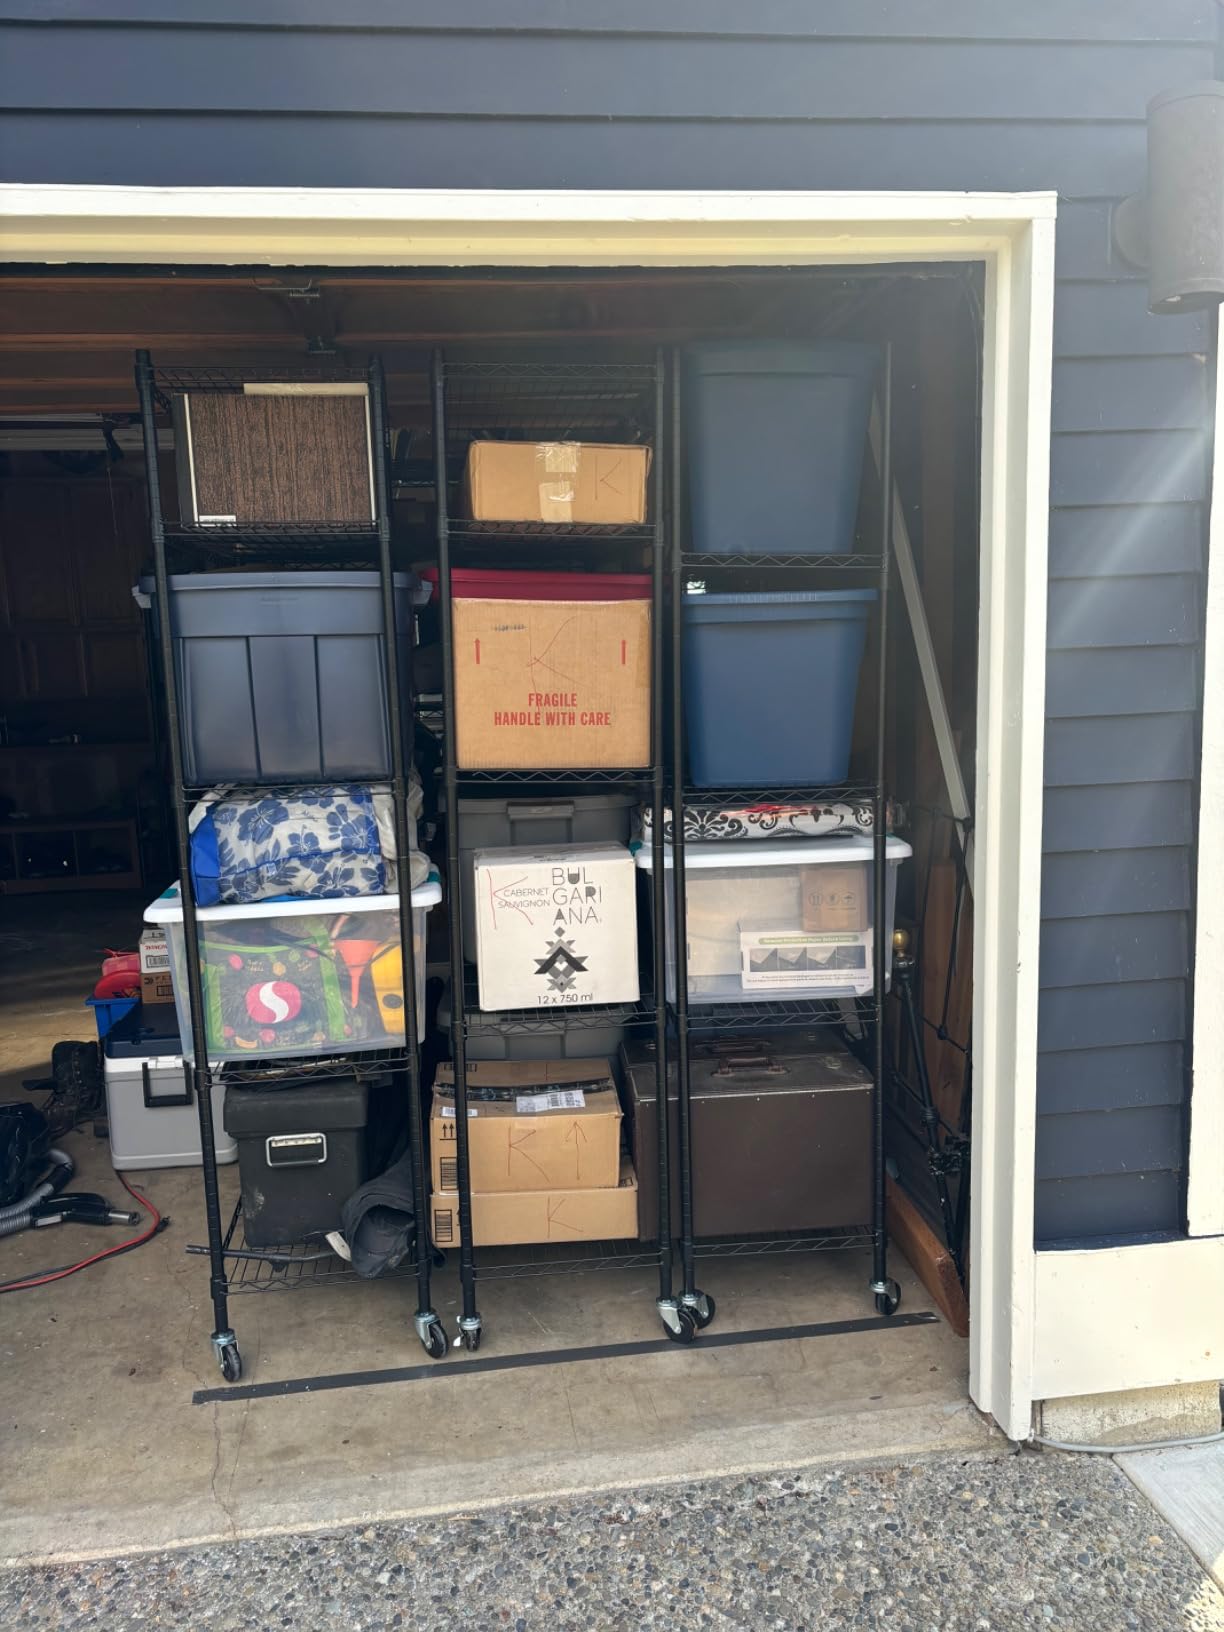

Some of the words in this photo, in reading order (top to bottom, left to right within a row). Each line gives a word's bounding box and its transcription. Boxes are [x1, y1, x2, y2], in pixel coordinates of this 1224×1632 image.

[594, 456, 624, 501] K
[528, 692, 578, 708] FRAGILE
[494, 711, 541, 726] HANDLE
[545, 711, 576, 726] WITH
[580, 711, 611, 726] CARE
[551, 866, 594, 886] BUL
[486, 868, 534, 930] K
[503, 887, 550, 898] CABERNET
[552, 885, 602, 906] GARI
[497, 899, 551, 910] SAUVIGNON
[537, 995, 549, 1005] 12
[551, 996, 558, 1005] x
[560, 993, 579, 1003] 750
[580, 992, 593, 1002] ml
[507, 1124, 550, 1183] K
[547, 1196, 585, 1239] K
